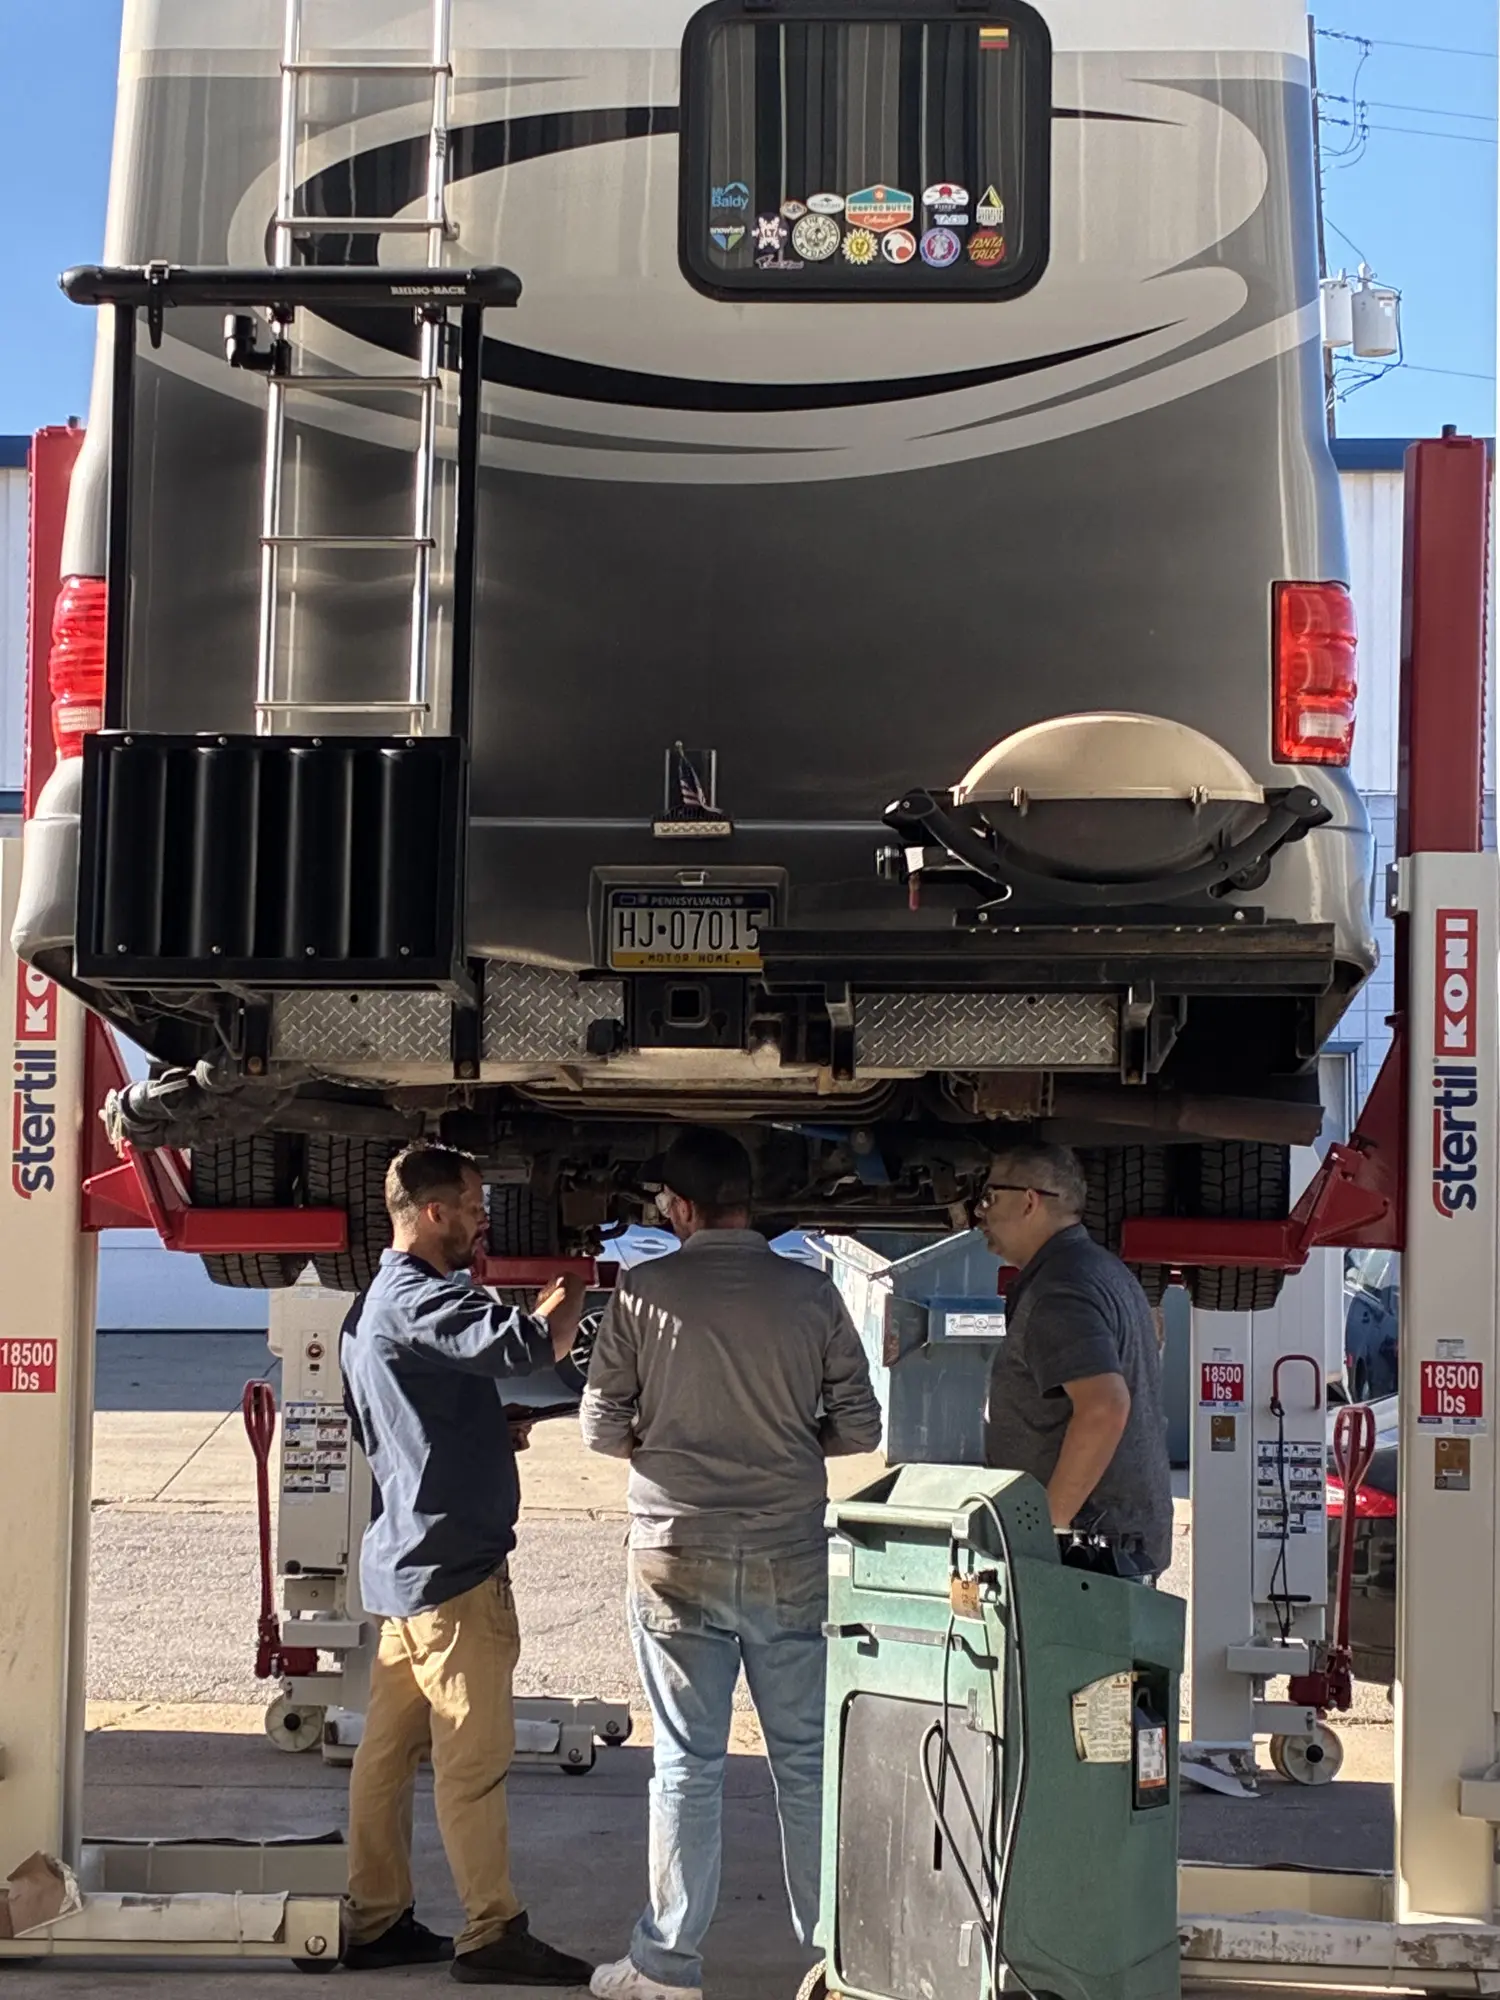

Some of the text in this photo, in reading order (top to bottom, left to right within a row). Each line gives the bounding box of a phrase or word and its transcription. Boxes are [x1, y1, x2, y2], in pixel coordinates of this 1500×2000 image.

[712, 195, 749, 211] Baldy
[967, 236, 1004, 249] SANTA
[970, 248, 1001, 260] CRUZ
[651, 896, 732, 906] PENNSYLVANIA
[648, 954, 731, 964] MOTOR HOME
[1432, 918, 1477, 1219] stertil KONI
[12, 965, 57, 1199] stertil KO
[0, 1342, 54, 1366] 18500
[12, 1366, 40, 1391] lbs
[1204, 1366, 1242, 1383] 18500
[1424, 1364, 1479, 1390] 18500
[1212, 1382, 1233, 1400] lbs
[1437, 1389, 1466, 1414] lbs
